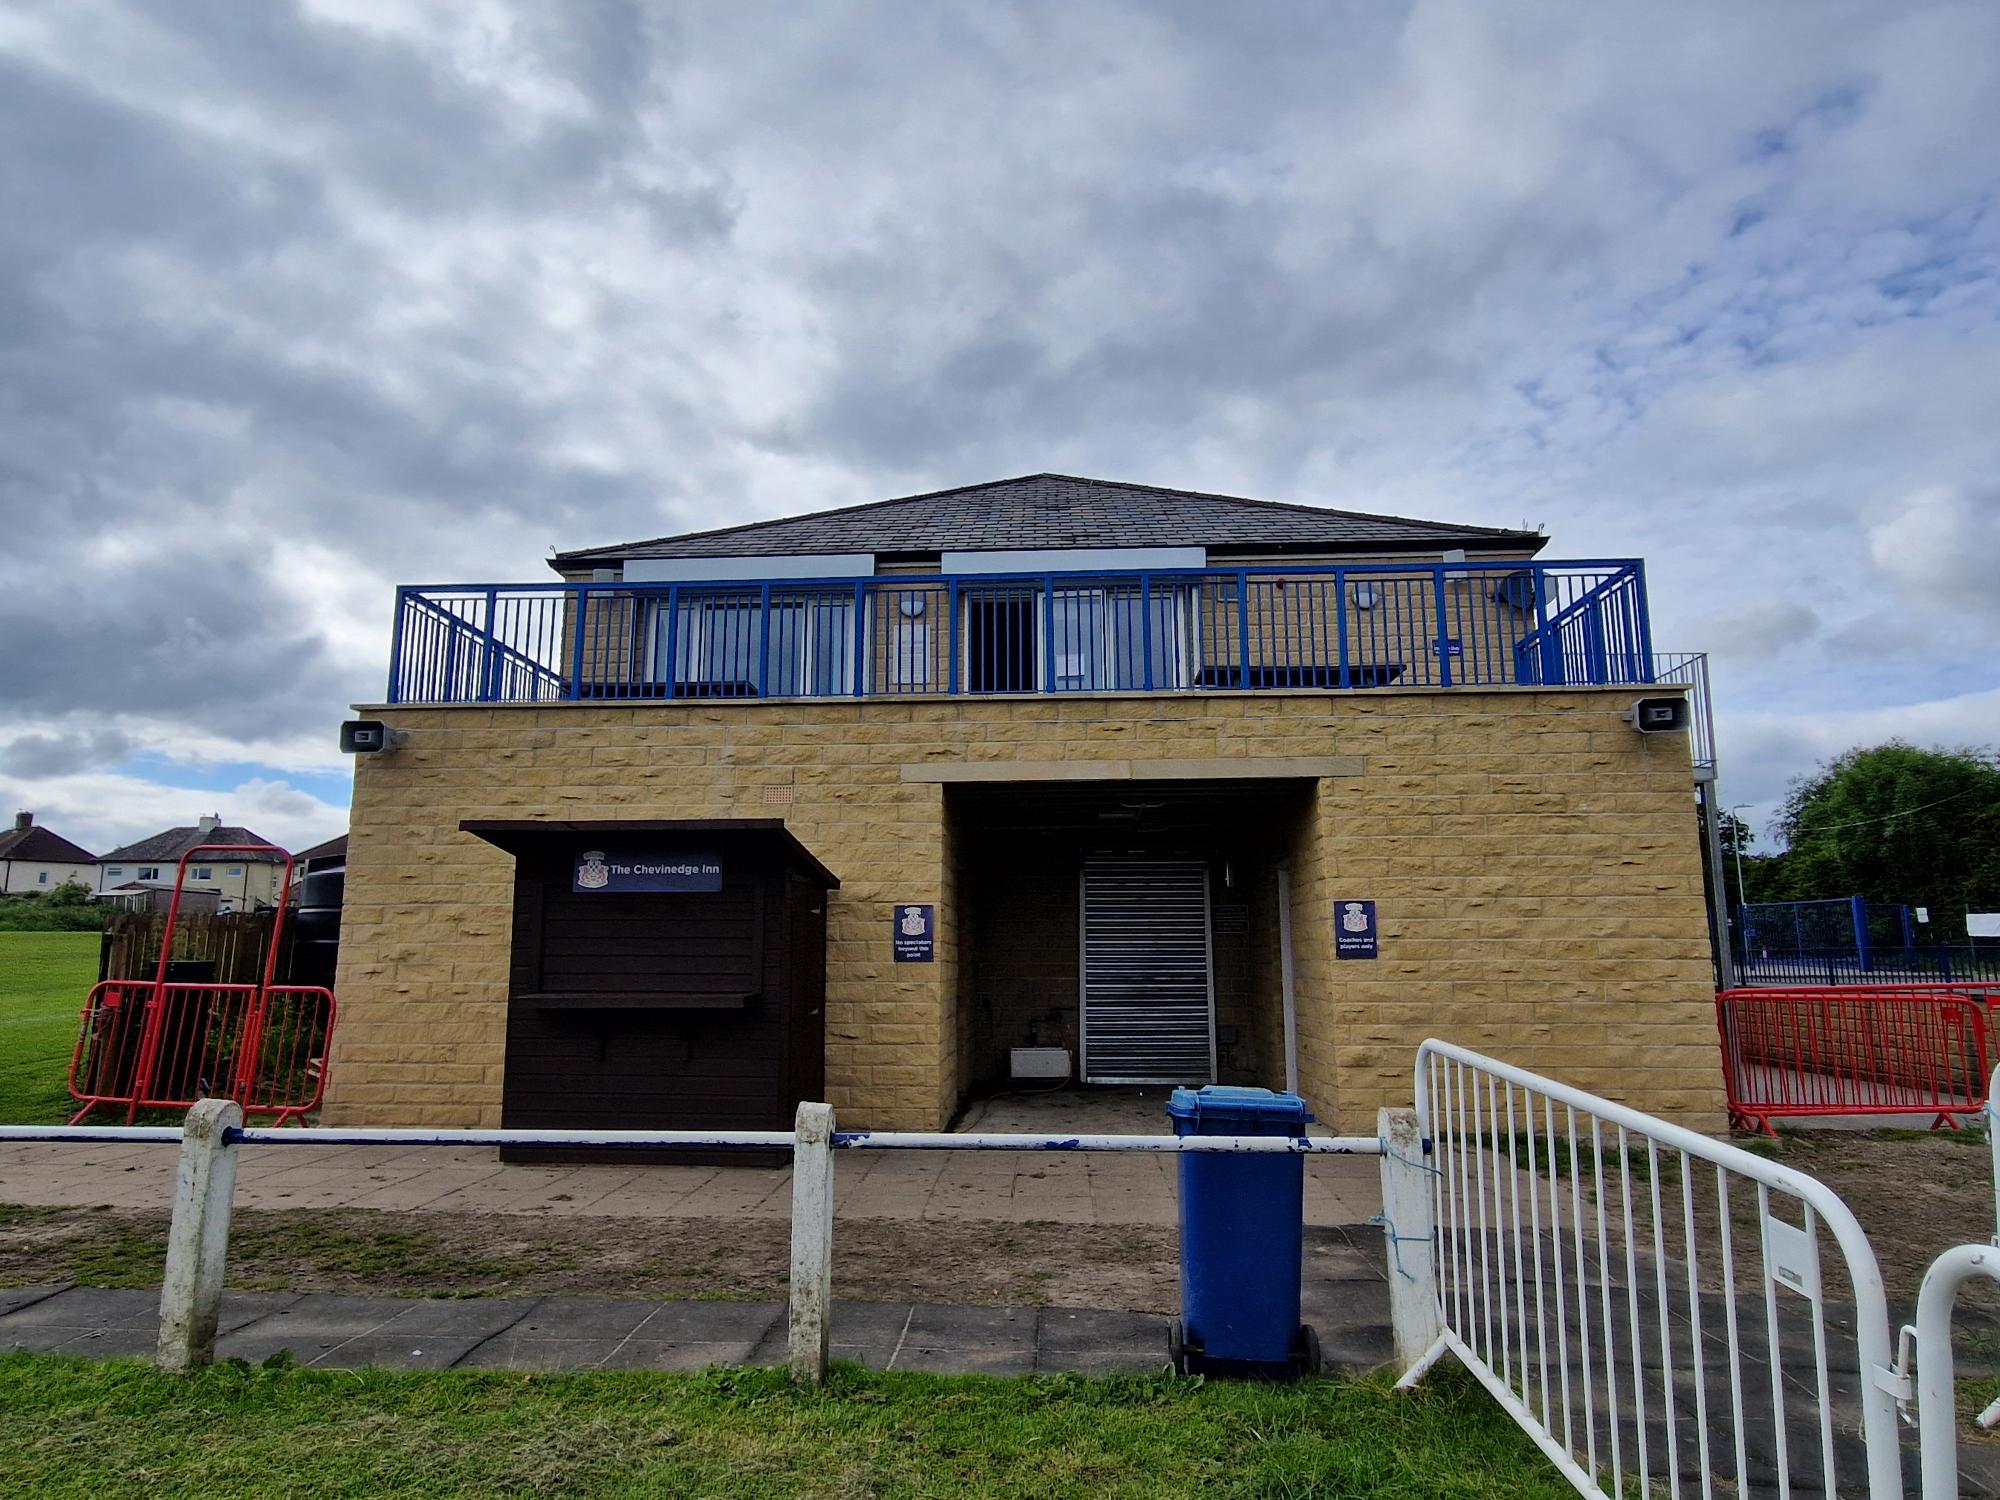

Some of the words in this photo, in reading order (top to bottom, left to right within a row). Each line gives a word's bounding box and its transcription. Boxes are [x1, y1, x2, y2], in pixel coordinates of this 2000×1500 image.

[610, 864, 631, 875] The
[633, 863, 700, 876] Chevinedge
[702, 864, 720, 874] Inn
